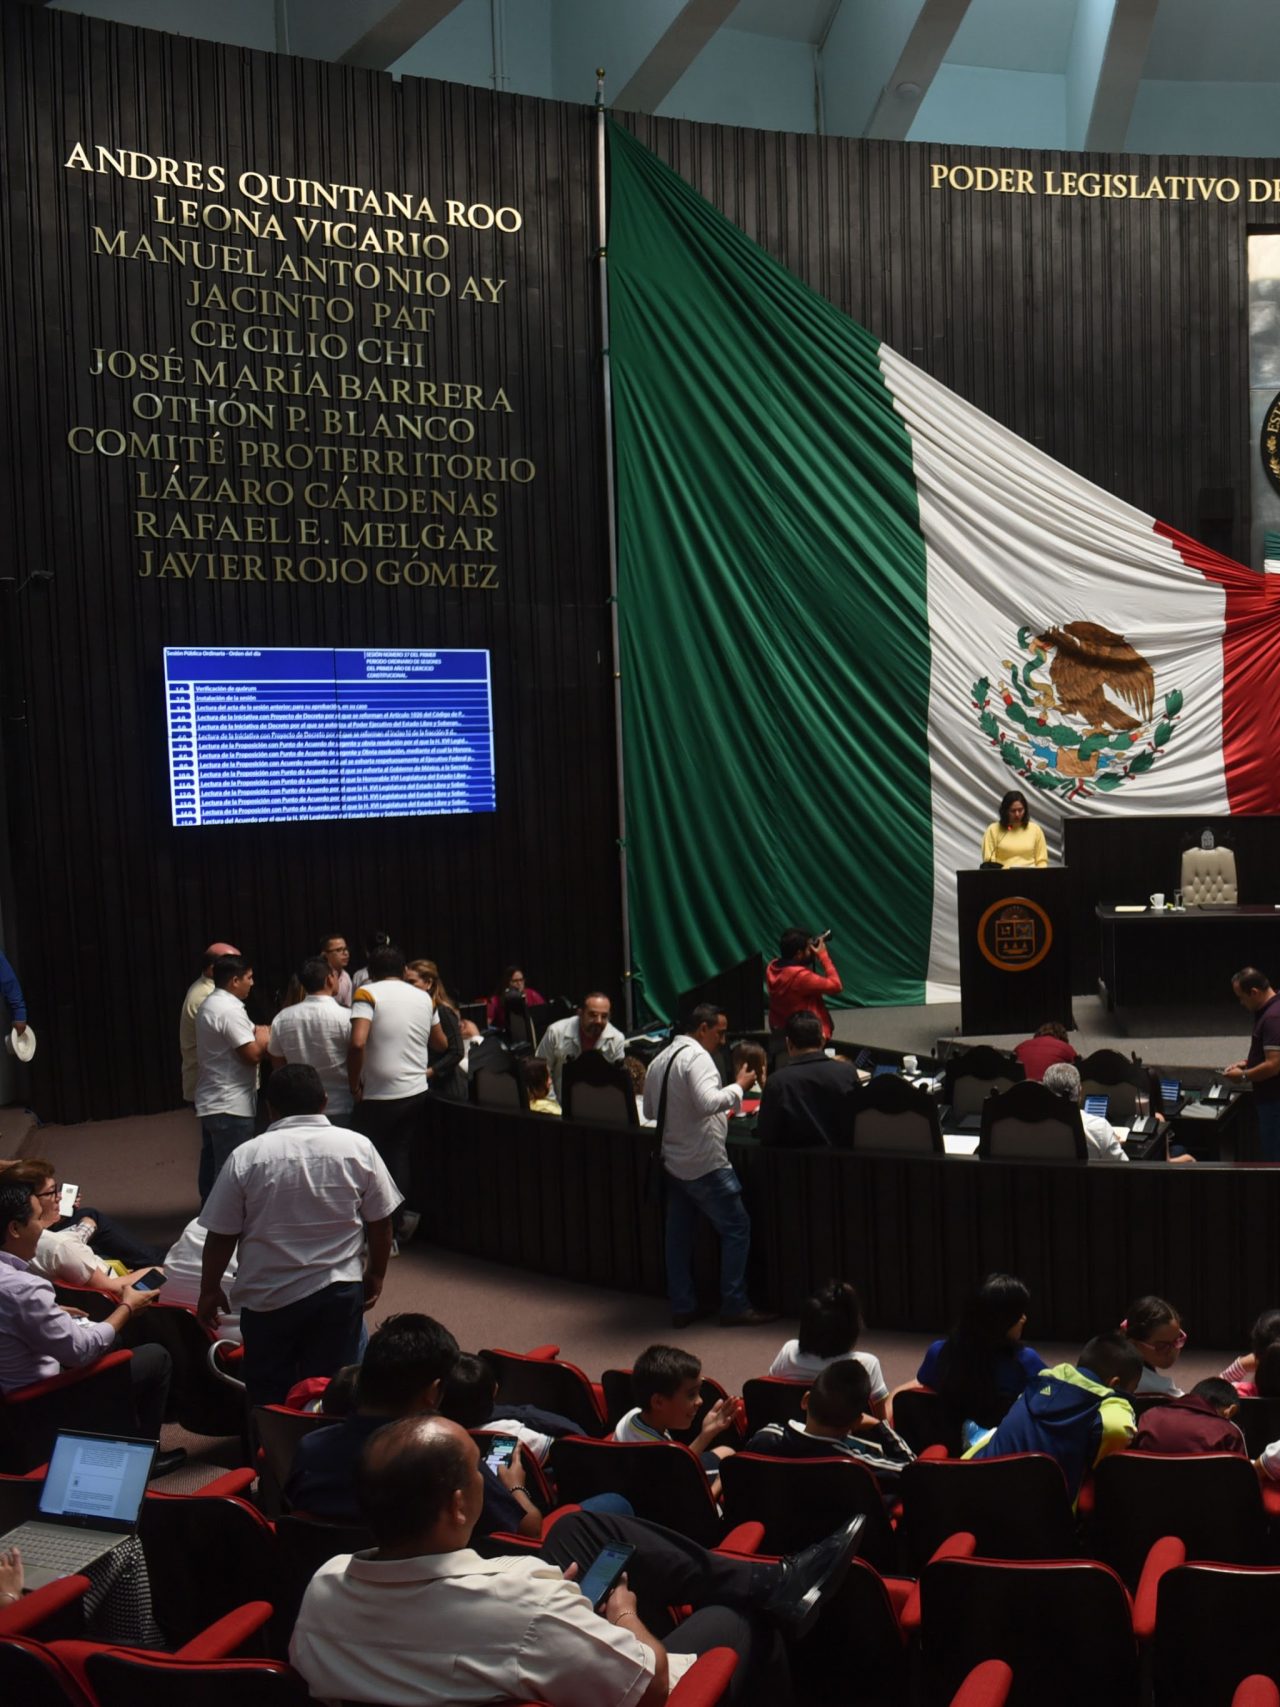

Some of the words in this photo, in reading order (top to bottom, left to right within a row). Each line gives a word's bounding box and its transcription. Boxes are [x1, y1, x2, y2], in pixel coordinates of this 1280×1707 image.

[64, 142, 225, 193] ANDRES
[239, 171, 438, 224] QUINTANA
[446, 200, 522, 233] ROO
[930, 164, 1037, 194] PODER
[1043, 171, 1240, 202] LEGISLATIVO
[153, 195, 287, 241] LEONA
[293, 216, 450, 260] VICARIO
[91, 226, 267, 278] MANUEL
[276, 253, 451, 298] ANTONIO
[460, 276, 507, 304] AY
[187, 280, 354, 324] JACINTO
[372, 302, 436, 333] PAT
[190, 320, 348, 361] CECILIO
[358, 337, 425, 368] CHI
[89, 347, 186, 383] JOSÉ
[192, 358, 331, 398] MARÍA
[338, 374, 514, 413] BARRERA
[132, 392, 275, 431] OTHÓN
[286, 406, 310, 432] P.
[322, 409, 475, 444] BLANCO
[67, 426, 226, 465] COMITÉ
[238, 440, 536, 483] PROTERRITORIO
[136, 464, 294, 507] LÁZARO
[304, 475, 498, 517] CÁRDENAS
[133, 510, 291, 543] RAFAEL
[297, 518, 330, 545] E.
[341, 521, 499, 552] MELGAR
[138, 550, 267, 581] JAVIER
[273, 556, 368, 584] ROJO
[375, 551, 499, 588] GÓMEZ
